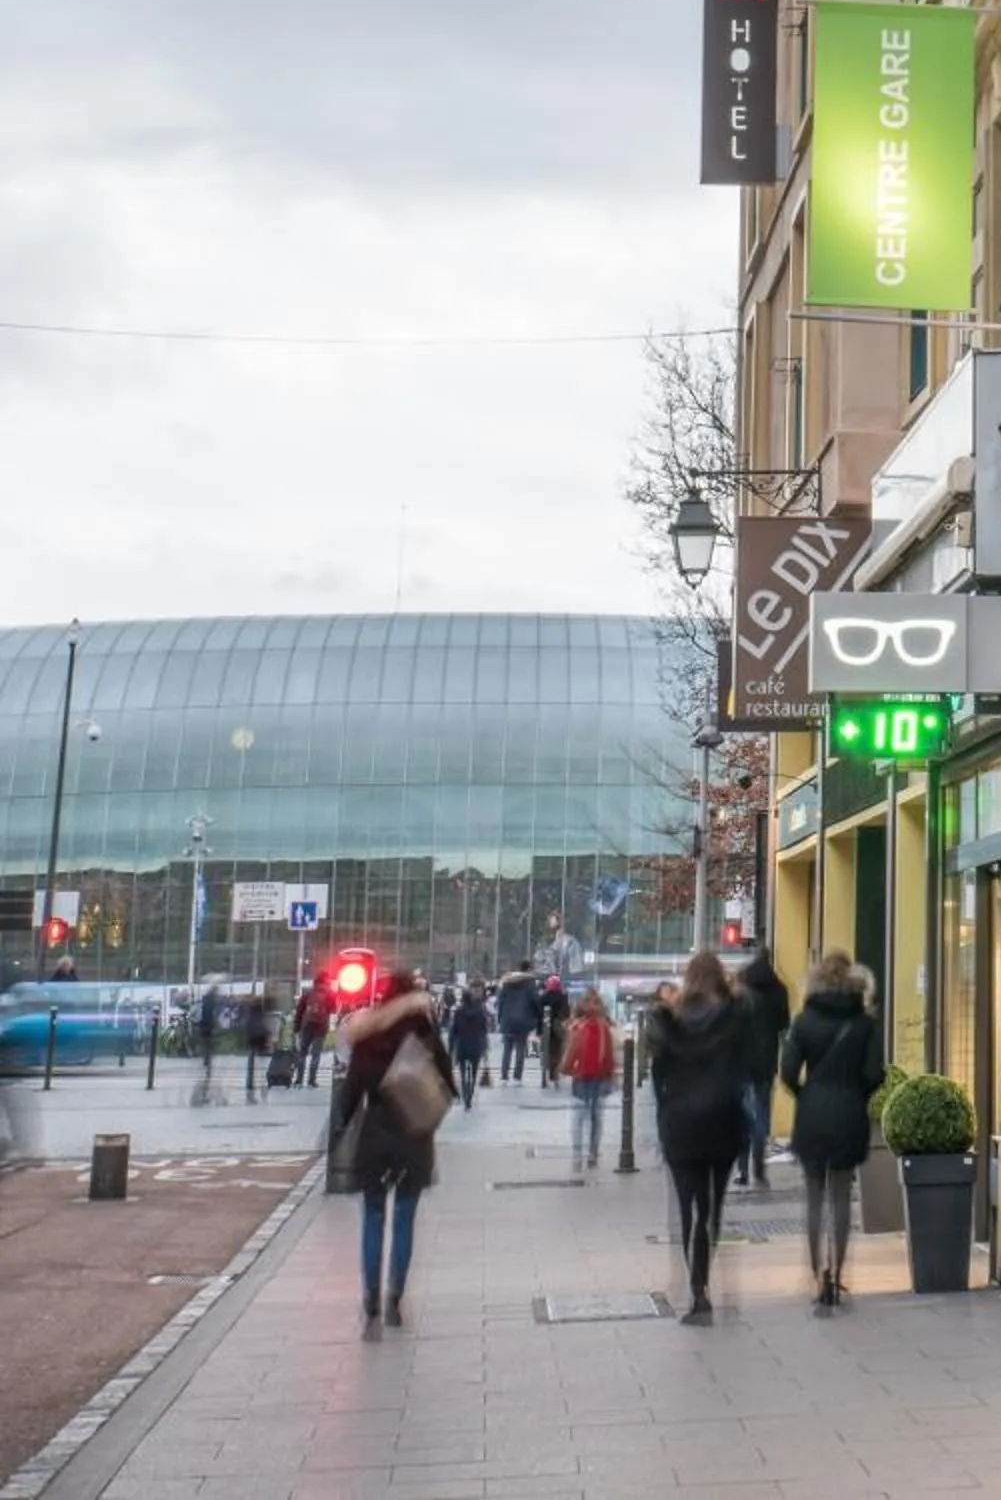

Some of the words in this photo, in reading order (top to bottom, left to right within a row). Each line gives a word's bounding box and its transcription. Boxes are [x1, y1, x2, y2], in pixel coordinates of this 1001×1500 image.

[729, 18, 752, 161] HOTEL
[879, 27, 912, 129] GARE
[875, 138, 911, 287] CENTRE
[738, 588, 793, 660] Le
[770, 520, 851, 596] DIX
[745, 674, 786, 695] café
[745, 700, 831, 718] restauran
